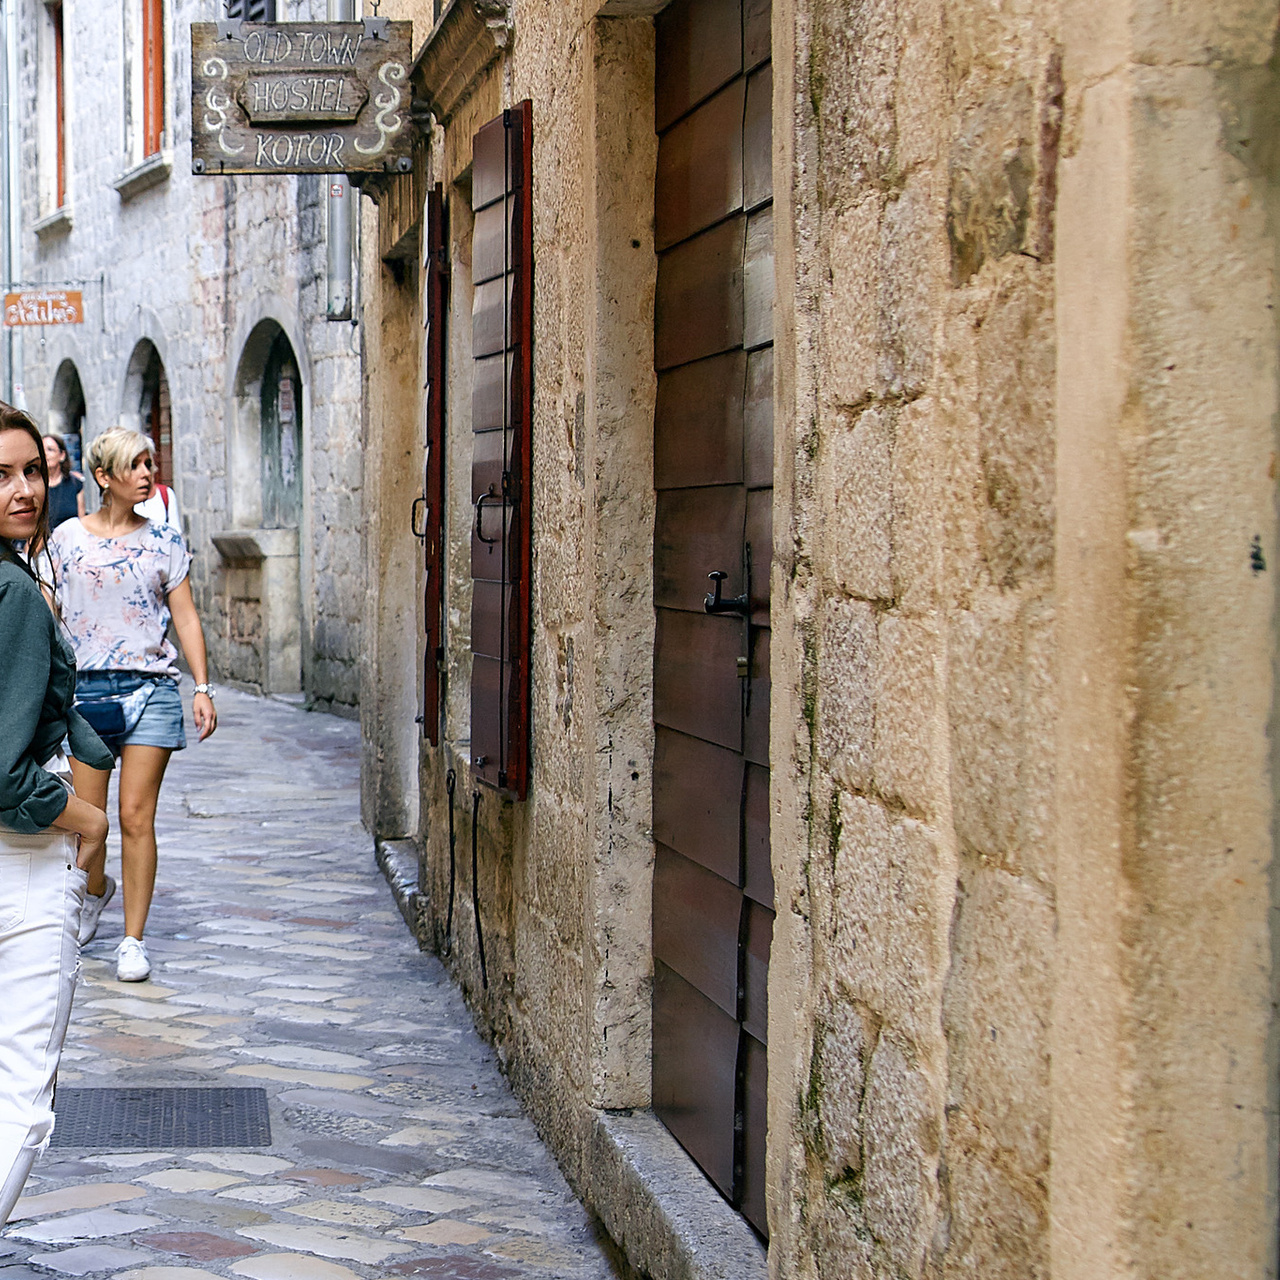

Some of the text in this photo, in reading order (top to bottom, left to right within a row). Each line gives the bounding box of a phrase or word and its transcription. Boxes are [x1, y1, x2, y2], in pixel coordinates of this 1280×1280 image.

[243, 30, 363, 66] OLD TOWN
[252, 78, 350, 113] HOSTEL
[255, 133, 345, 168] KOTOR
